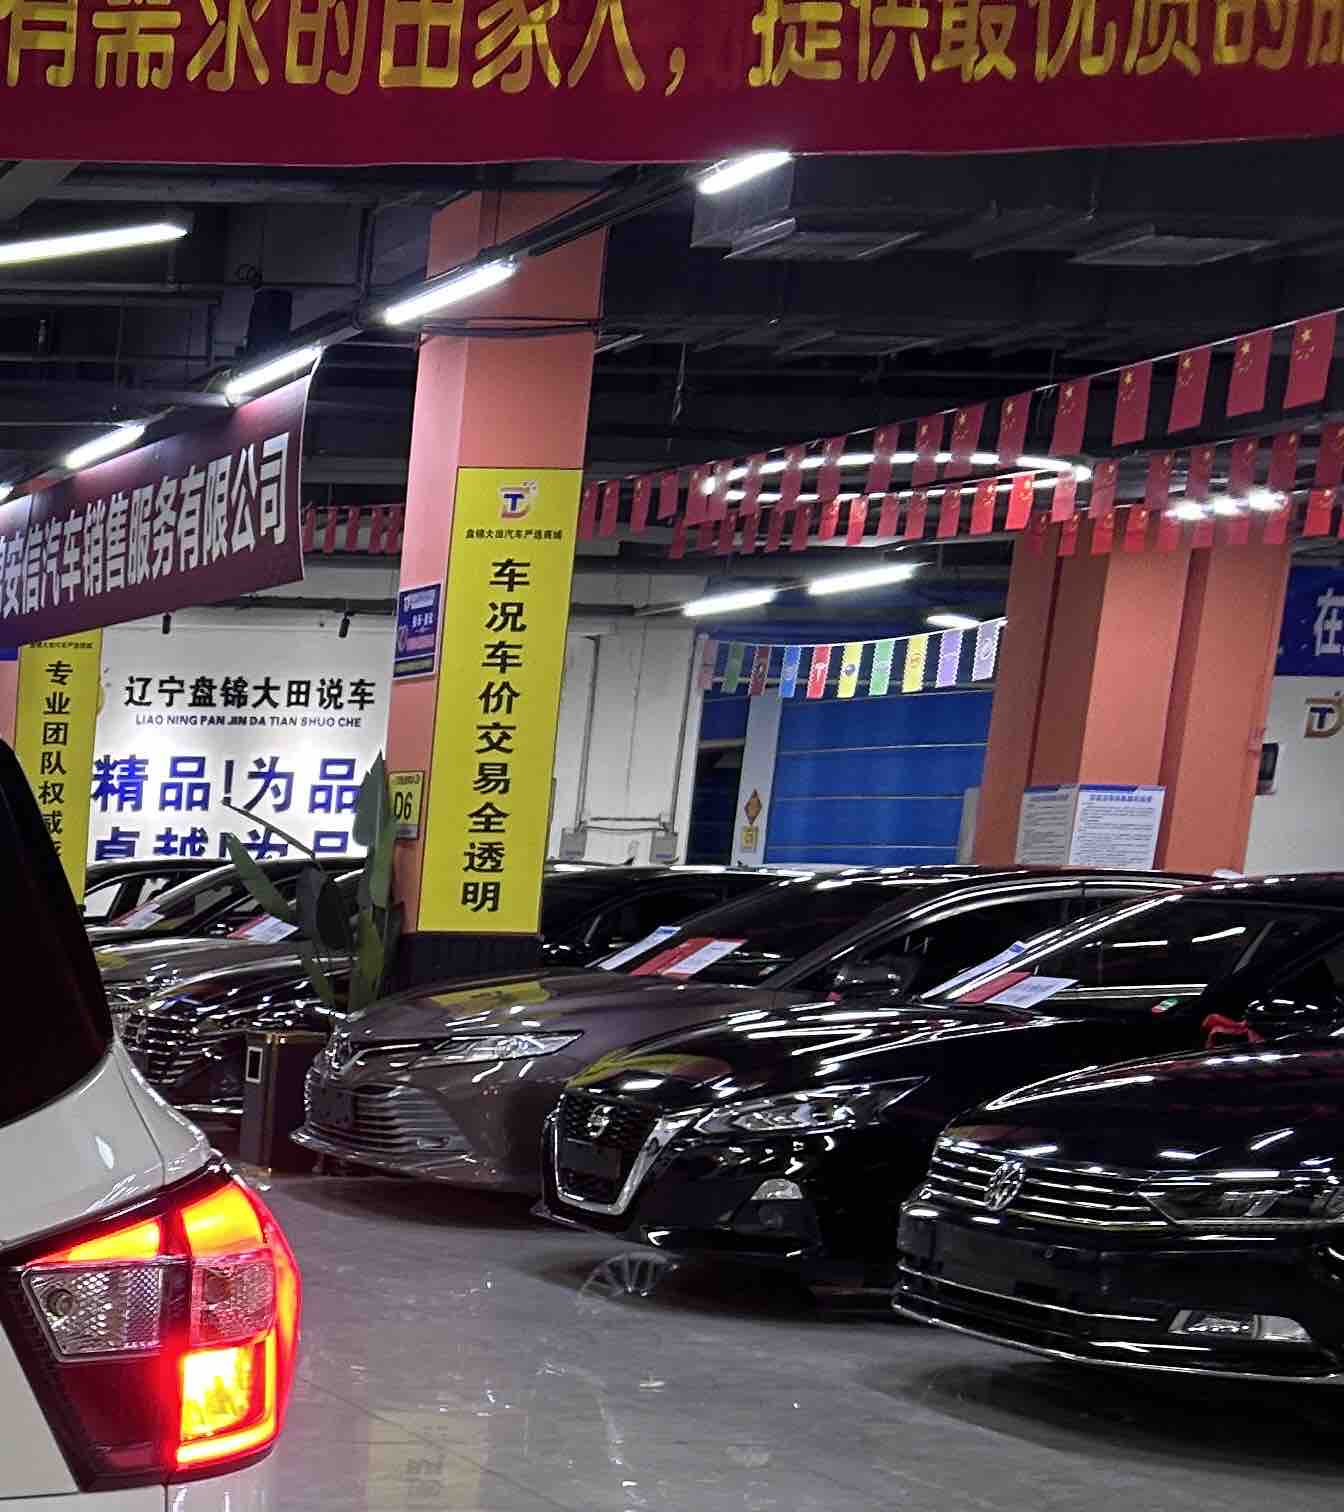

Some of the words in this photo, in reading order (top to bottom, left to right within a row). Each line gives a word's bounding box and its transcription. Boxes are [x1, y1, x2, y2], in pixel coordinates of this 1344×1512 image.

[124, 675, 376, 710] 辽宁盘锦大田说车
[135, 714, 163, 726] LIAO
[166, 714, 198, 726] NING
[199, 715, 225, 726] PAN
[227, 715, 249, 727] JIN
[249, 715, 267, 727] DA
[269, 715, 297, 728] TIAN
[300, 716, 336, 728] SHUO
[337, 716, 362, 728] CHE
[460, 557, 531, 913] 车况车价交易全透明
[37, 660, 74, 857] 专业团队权威
